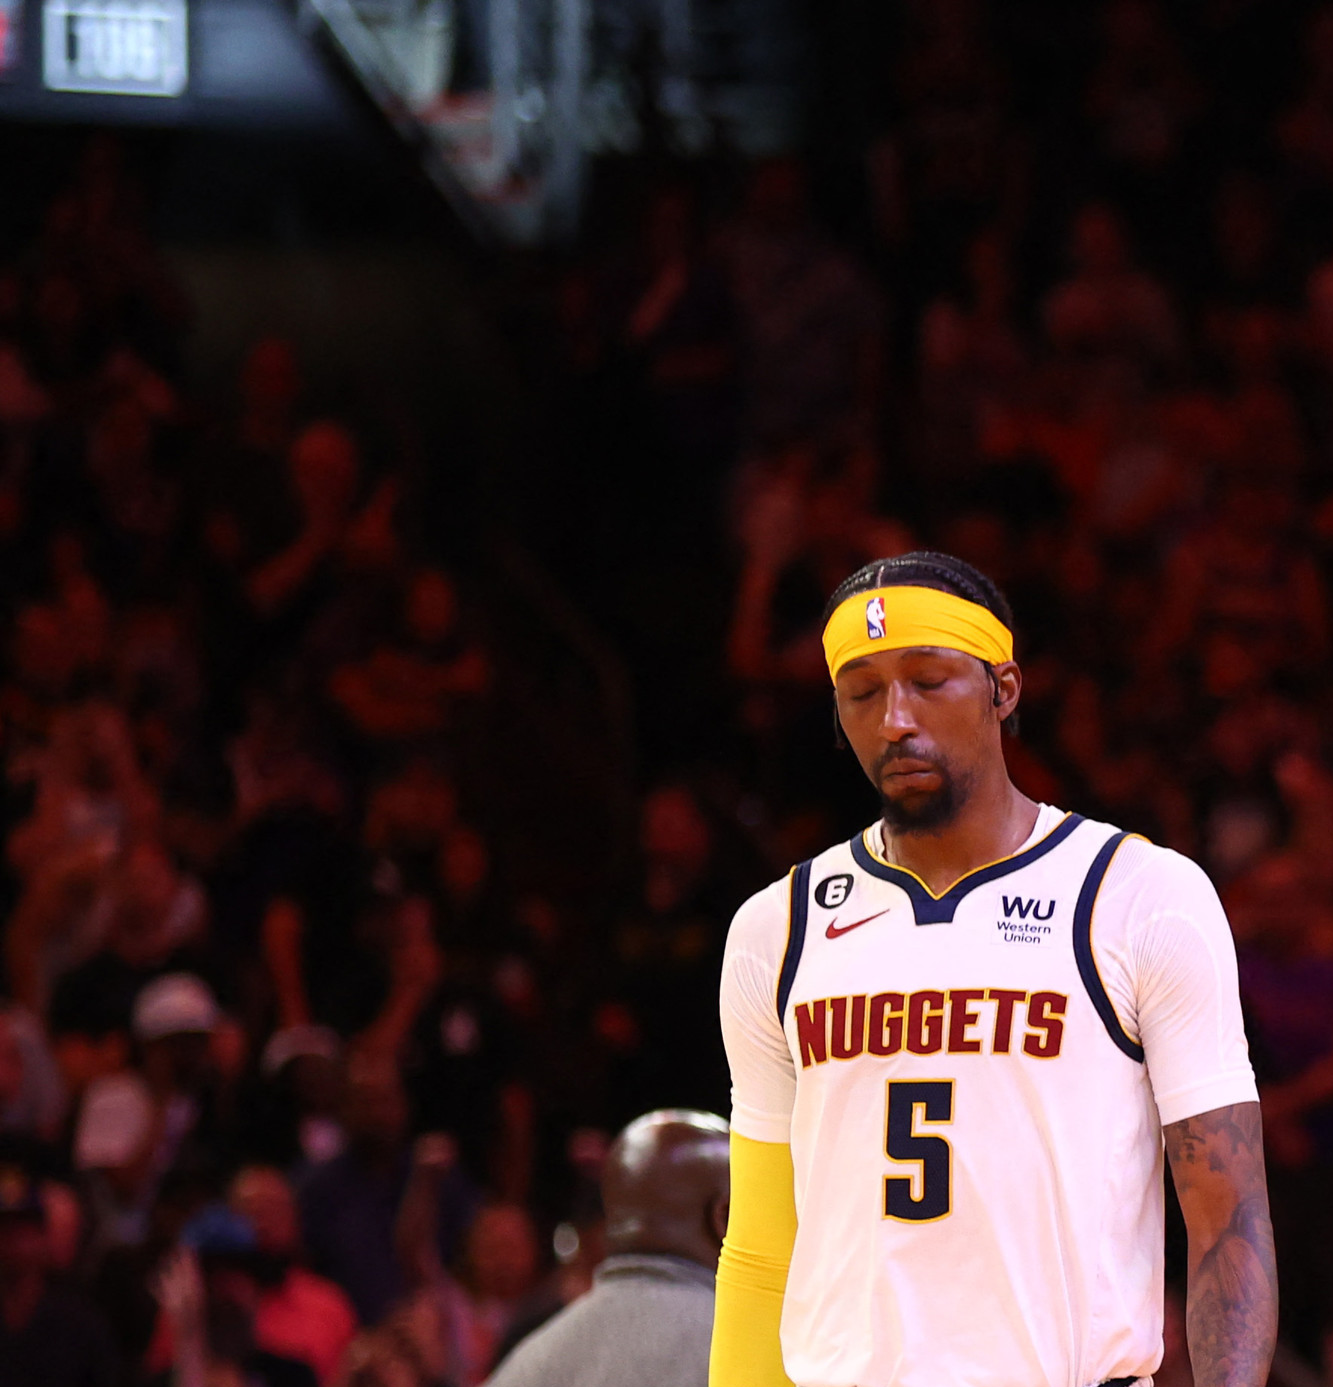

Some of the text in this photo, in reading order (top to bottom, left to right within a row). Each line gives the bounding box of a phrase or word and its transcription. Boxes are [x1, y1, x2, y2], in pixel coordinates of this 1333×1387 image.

[824, 877, 849, 907] 6
[1002, 895, 1056, 921] WU
[997, 920, 1051, 934] Western
[1004, 932, 1041, 944] Union
[794, 988, 1068, 1070] NUGGETS
[881, 1078, 956, 1225] 5
